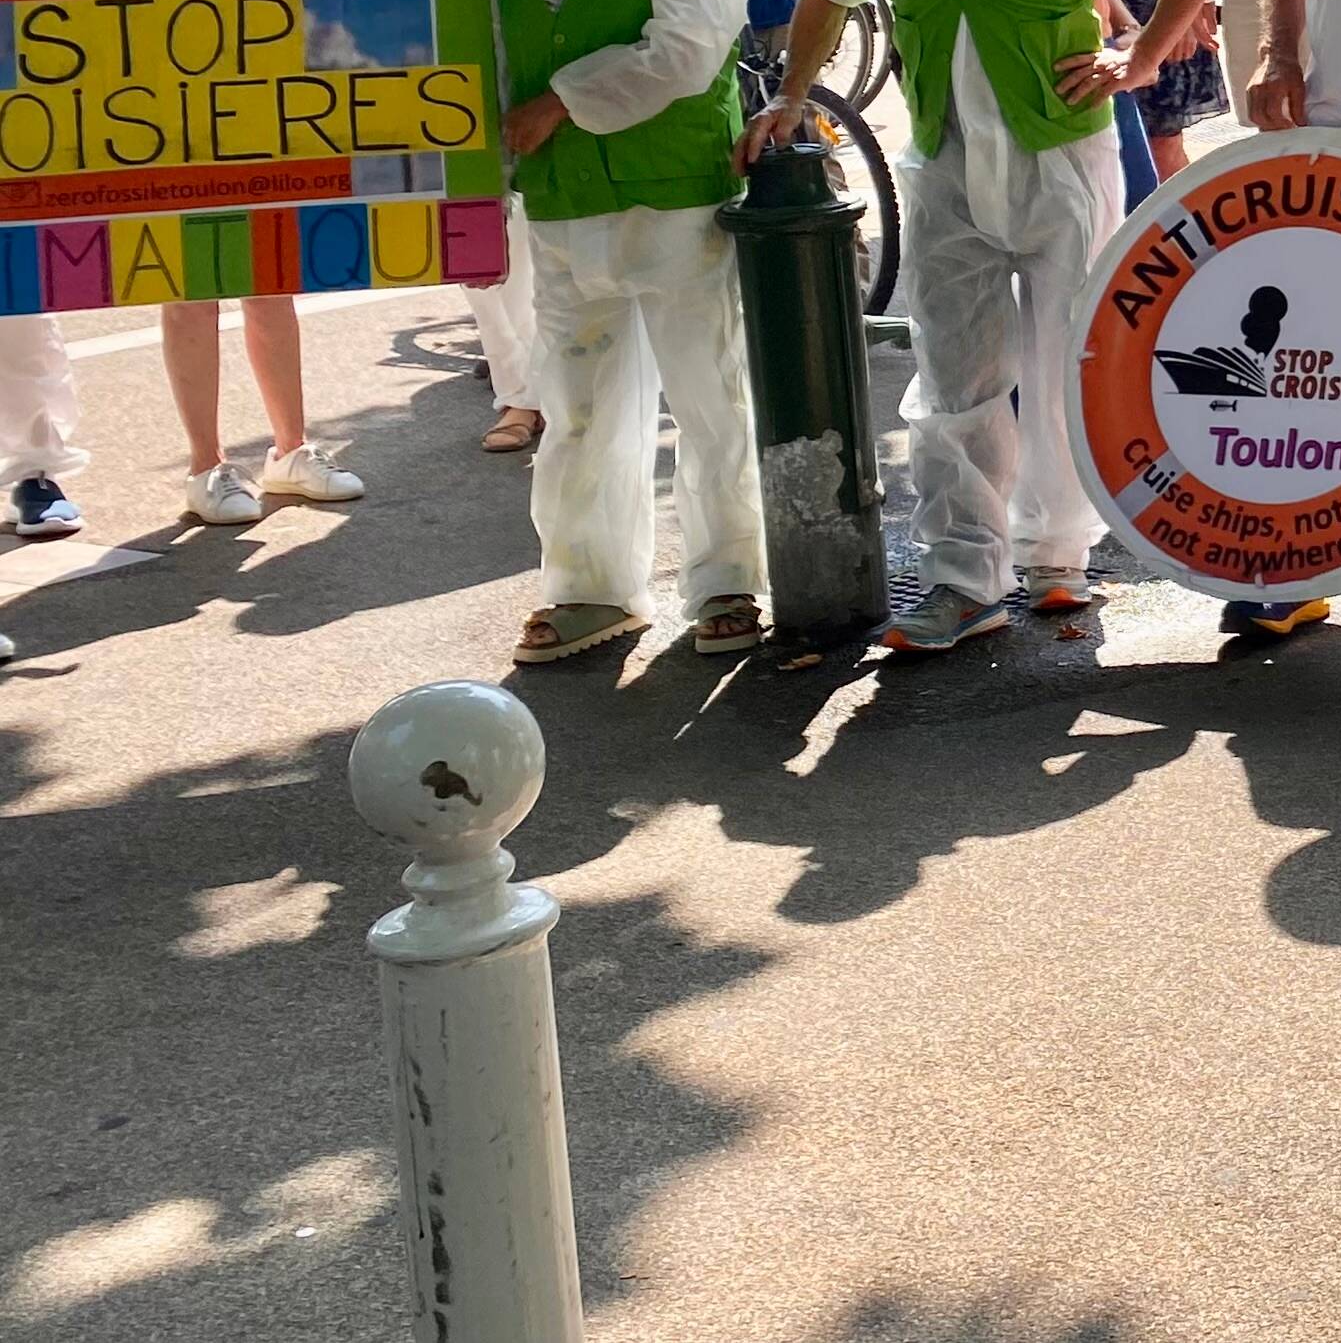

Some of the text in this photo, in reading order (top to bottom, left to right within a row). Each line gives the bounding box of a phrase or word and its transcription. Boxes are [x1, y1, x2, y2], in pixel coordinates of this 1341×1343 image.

[1272, 349, 1334, 374] STOP
[1123, 437, 1194, 514] Cruise
[1197, 497, 1283, 543] ships,
[1151, 514, 1200, 558] not
